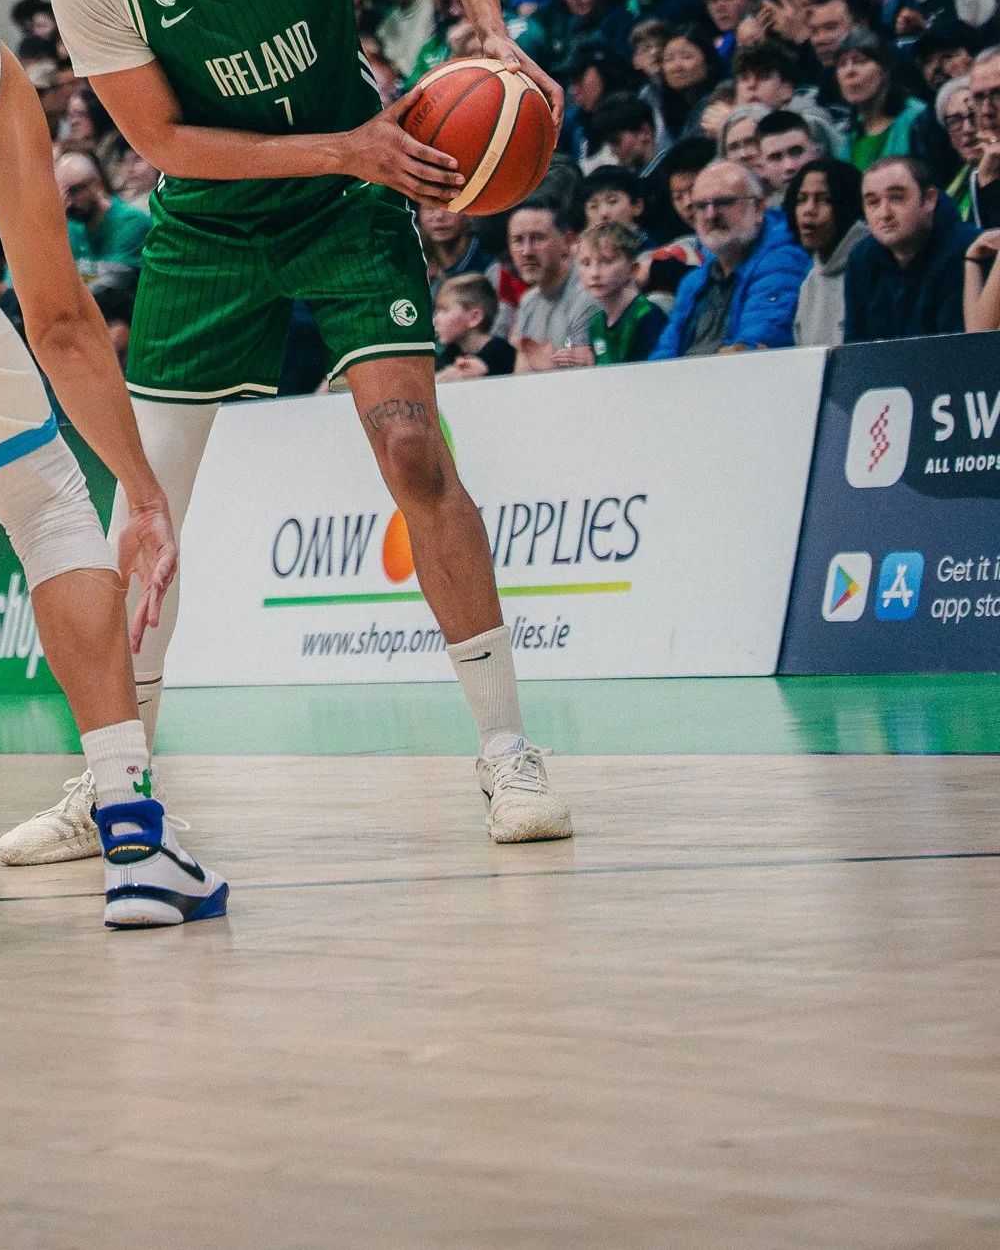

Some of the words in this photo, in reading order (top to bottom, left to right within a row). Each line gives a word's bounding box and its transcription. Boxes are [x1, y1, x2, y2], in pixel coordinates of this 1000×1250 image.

[205, 21, 318, 97] IRELAND
[274, 96, 294, 126] 7
[924, 457, 950, 475] ALL
[272, 513, 377, 579] OMW
[937, 556, 974, 582] Get
[977, 556, 991, 581] it
[931, 597, 971, 624] app
